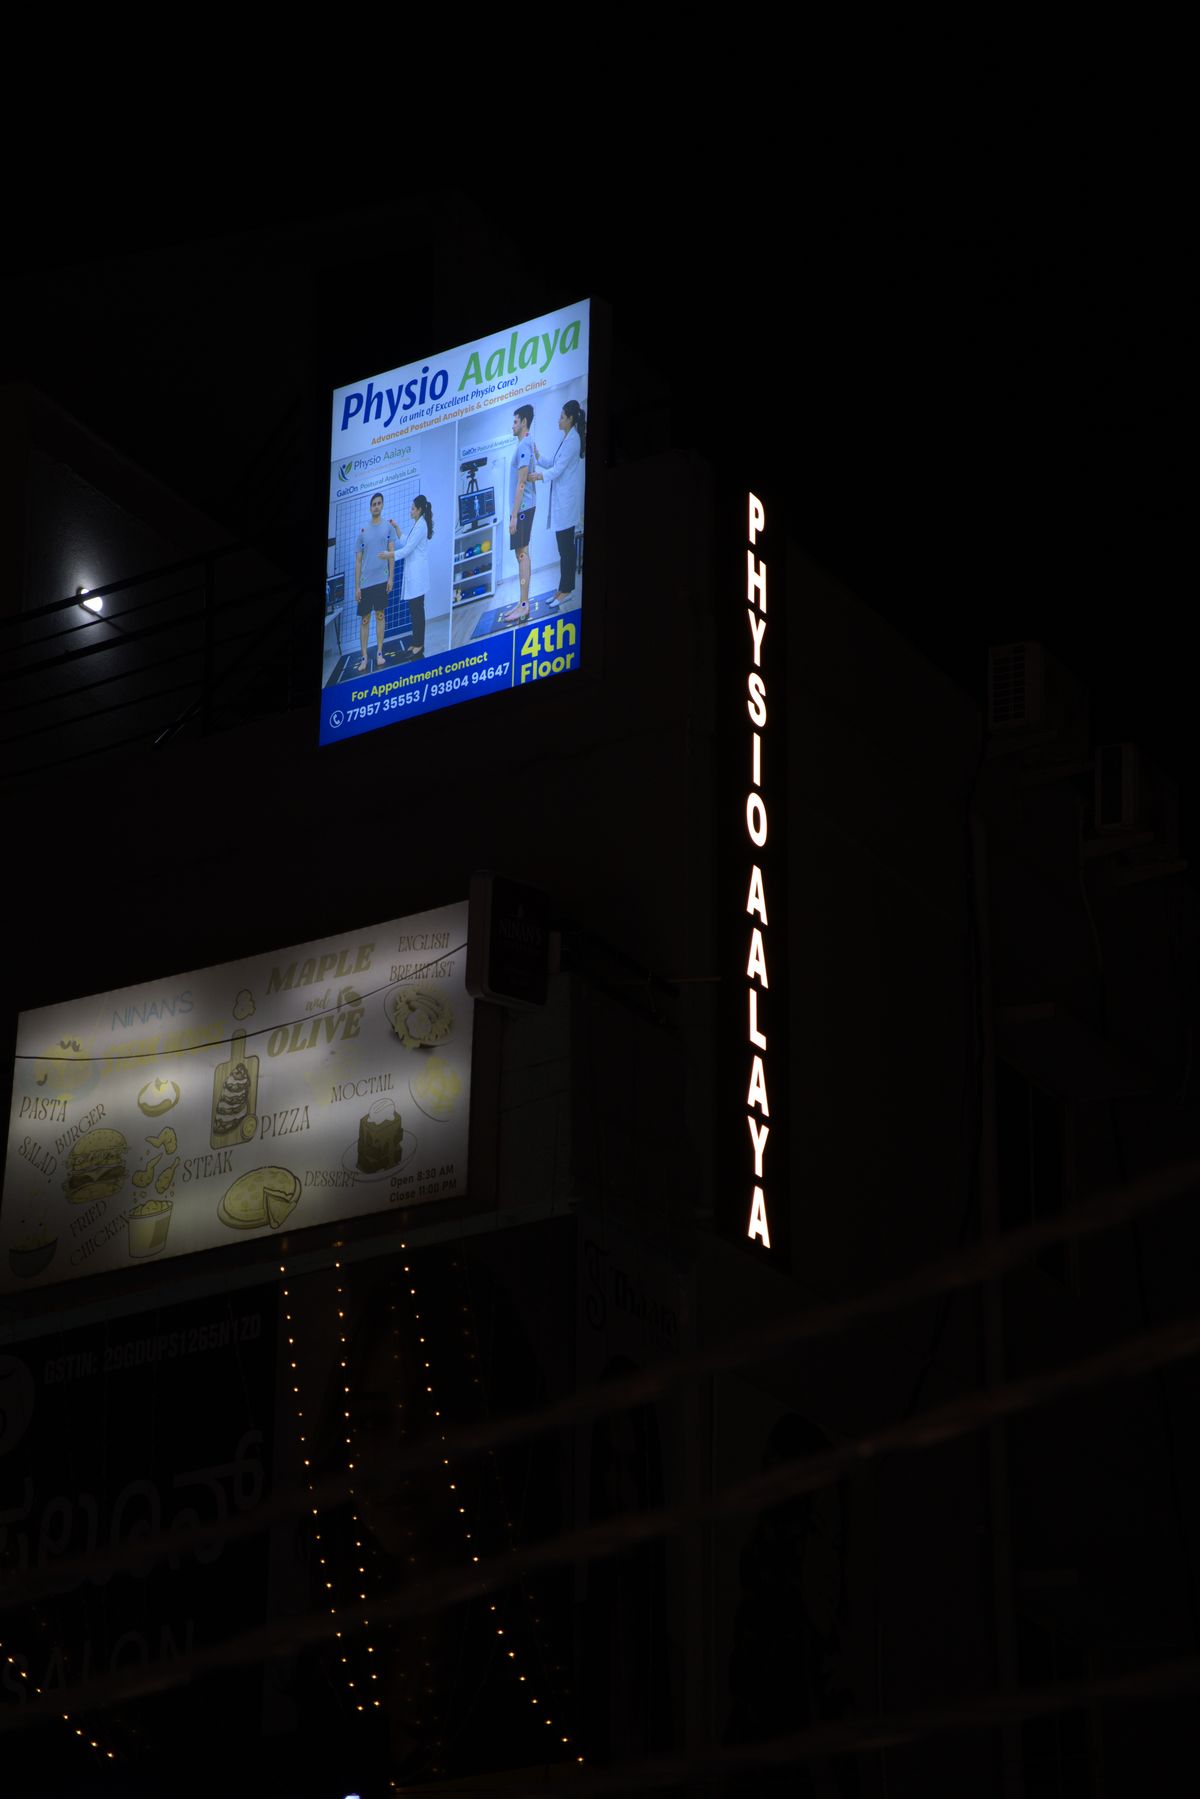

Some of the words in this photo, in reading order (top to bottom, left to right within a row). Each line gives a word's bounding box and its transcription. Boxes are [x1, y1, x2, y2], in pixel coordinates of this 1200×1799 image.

[341, 366, 449, 431] Physio
[458, 320, 581, 392] Aalaya
[371, 427, 409, 446] Advanced
[410, 415, 442, 432] Postural
[443, 404, 475, 422] Analysis
[476, 401, 482, 411] &
[483, 388, 524, 407] Correction
[524, 377, 547, 393] Clinic
[400, 414, 409, 425] (a
[409, 409, 426, 423] unit
[426, 404, 435, 418] of
[435, 393, 470, 412] Excellent
[471, 385, 496, 401] Physio
[497, 375, 519, 391] Care)
[354, 455, 381, 470] Physio
[383, 446, 412, 460] Aalaya
[520, 618, 576, 658] 4th
[351, 689, 369, 702] For
[371, 665, 443, 698] Appointment
[444, 651, 488, 674] contact
[520, 652, 575, 684] Floor
[747, 492, 767, 847] PHYSIO
[346, 702, 381, 722] 77957
[382, 690, 420, 711] 35553
[430, 677, 469, 697] 93804
[471, 662, 510, 685] 94647
[397, 931, 450, 953] ENGLISH
[265, 942, 376, 996] MAPLE
[389, 960, 455, 982] BREAKFAST
[304, 992, 330, 1012] and
[265, 1007, 365, 1058] OLIVE
[747, 864, 771, 1249] AALAYA
[330, 1073, 394, 1104] MOCTAIL
[18, 1095, 67, 1123] PASTA
[54, 1103, 107, 1155] BURGER
[259, 1105, 310, 1140] PIZZA
[18, 1136, 57, 1178] SALAD
[182, 1150, 234, 1183] STEAK
[390, 1175, 414, 1188] Open
[439, 1164, 454, 1176] AM
[304, 1170, 358, 1189] DESSERT
[390, 1190, 415, 1202] Close
[442, 1179, 457, 1191] PM
[69, 1199, 108, 1239] FRIED
[69, 1211, 129, 1266] CHICKEN
